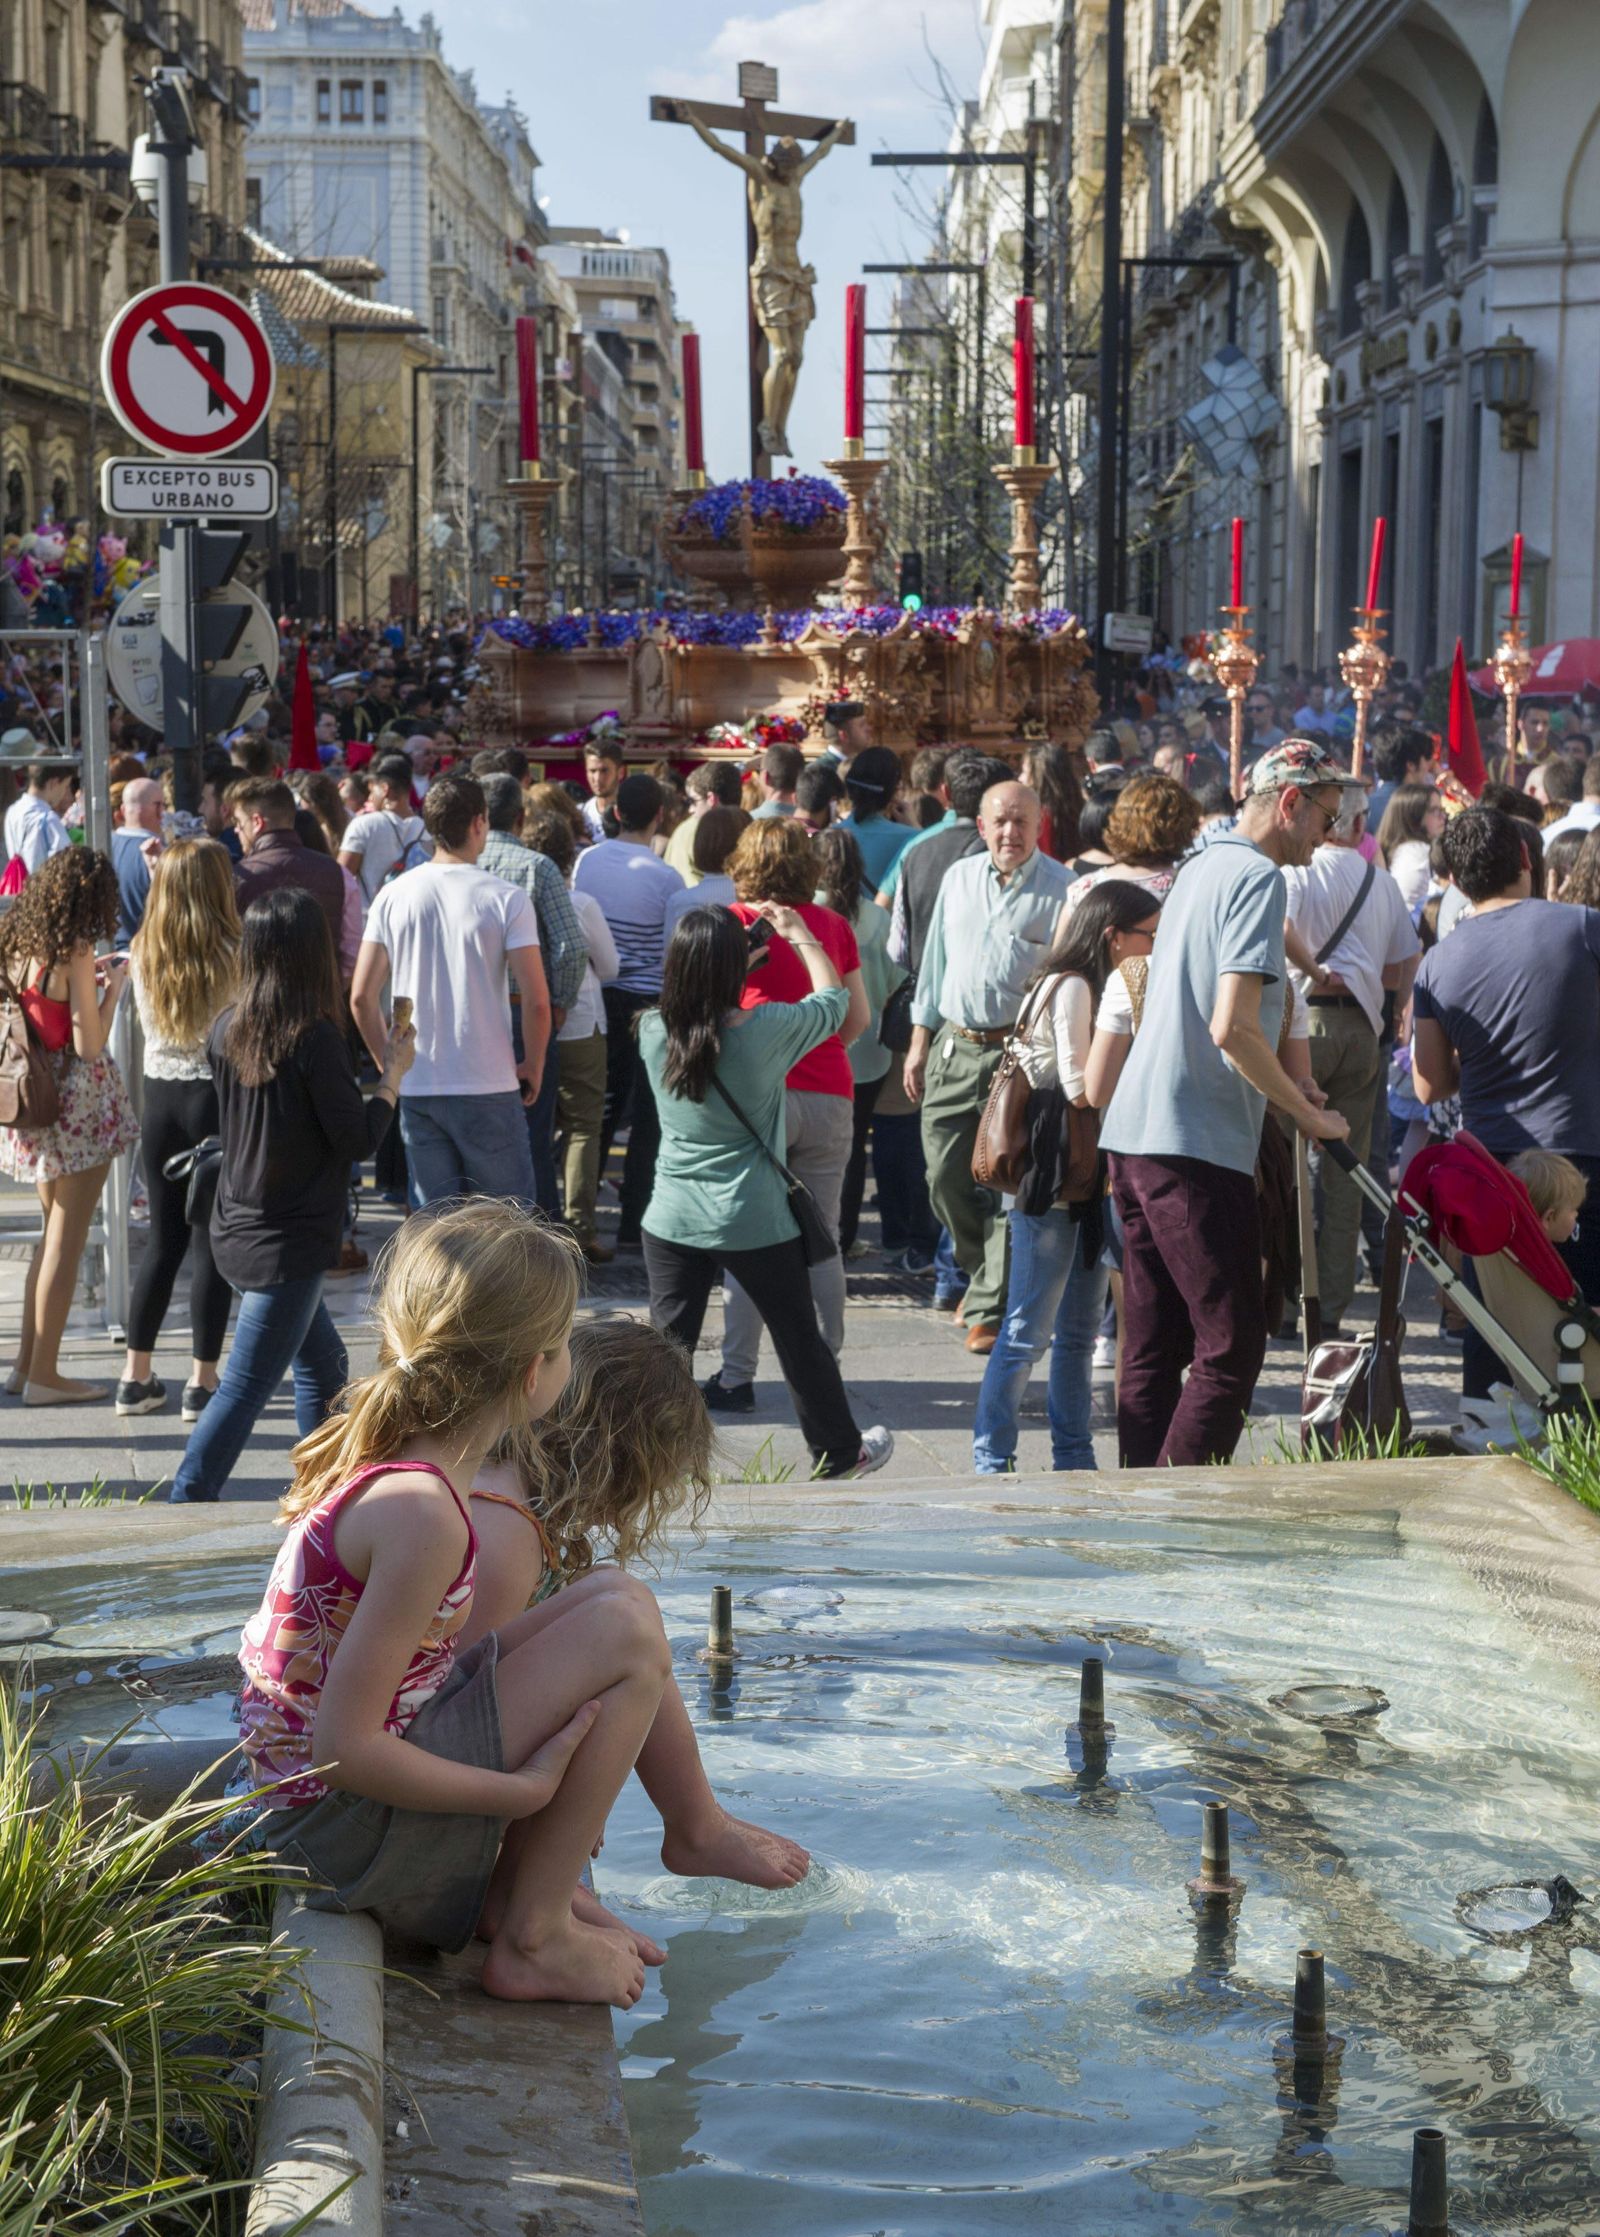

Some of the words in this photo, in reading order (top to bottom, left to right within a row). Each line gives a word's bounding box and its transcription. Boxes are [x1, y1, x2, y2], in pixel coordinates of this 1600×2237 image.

[123, 470, 210, 486] EXCEPTO
[217, 472, 255, 487] BUS
[152, 493, 234, 507] URBANO
